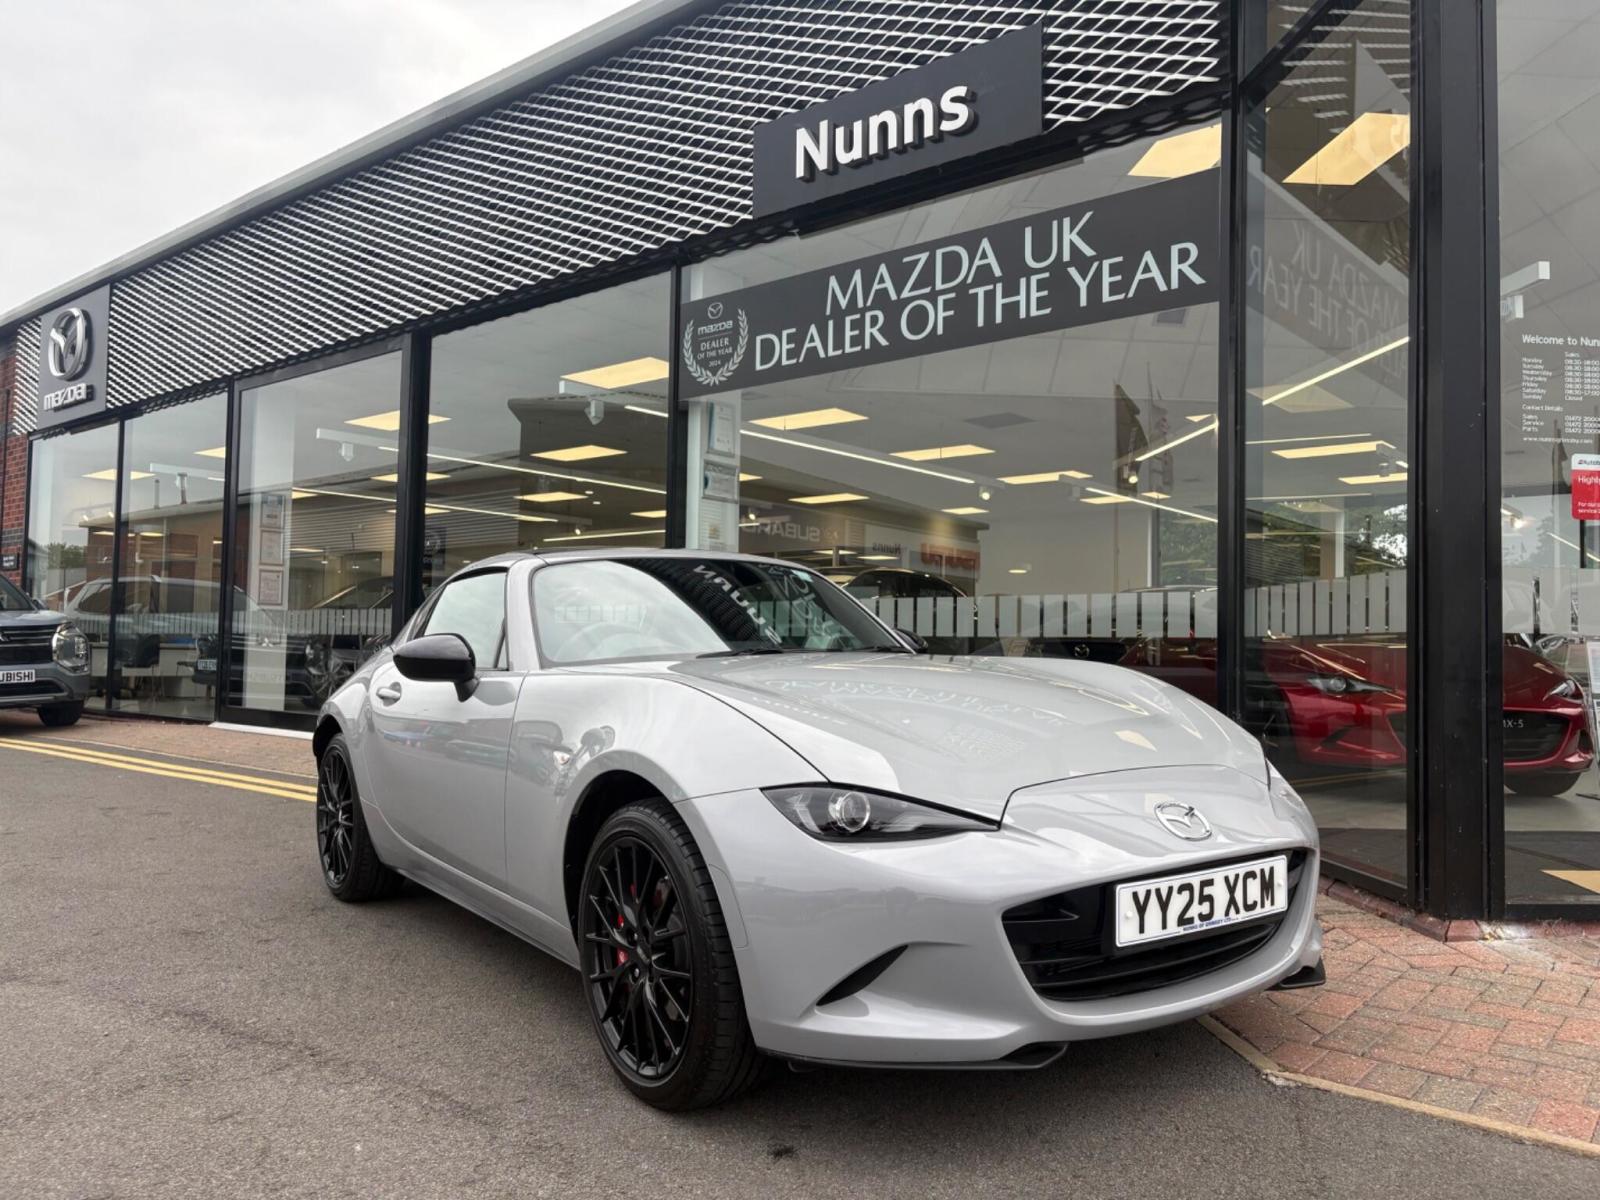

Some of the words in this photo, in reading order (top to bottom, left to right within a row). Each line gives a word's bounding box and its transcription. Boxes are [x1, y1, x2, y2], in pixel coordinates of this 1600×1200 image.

[796, 85, 971, 179] Nunns
[825, 237, 1002, 316] MAZDA
[1024, 211, 1098, 269] UK
[754, 309, 890, 372] DEALER
[900, 293, 956, 341] OF
[969, 272, 1053, 328] THE
[1067, 241, 1207, 308] YEAR
[697, 320, 733, 335] mazda
[1522, 334, 1565, 345] Welcome
[1568, 336, 1577, 346] to
[700, 337, 729, 351] DEALER
[706, 350, 717, 358] THE
[718, 346, 733, 355] YEAR
[43, 382, 87, 411] mazda
[1132, 878, 1215, 935] YY25
[1224, 866, 1275, 917] XCM
